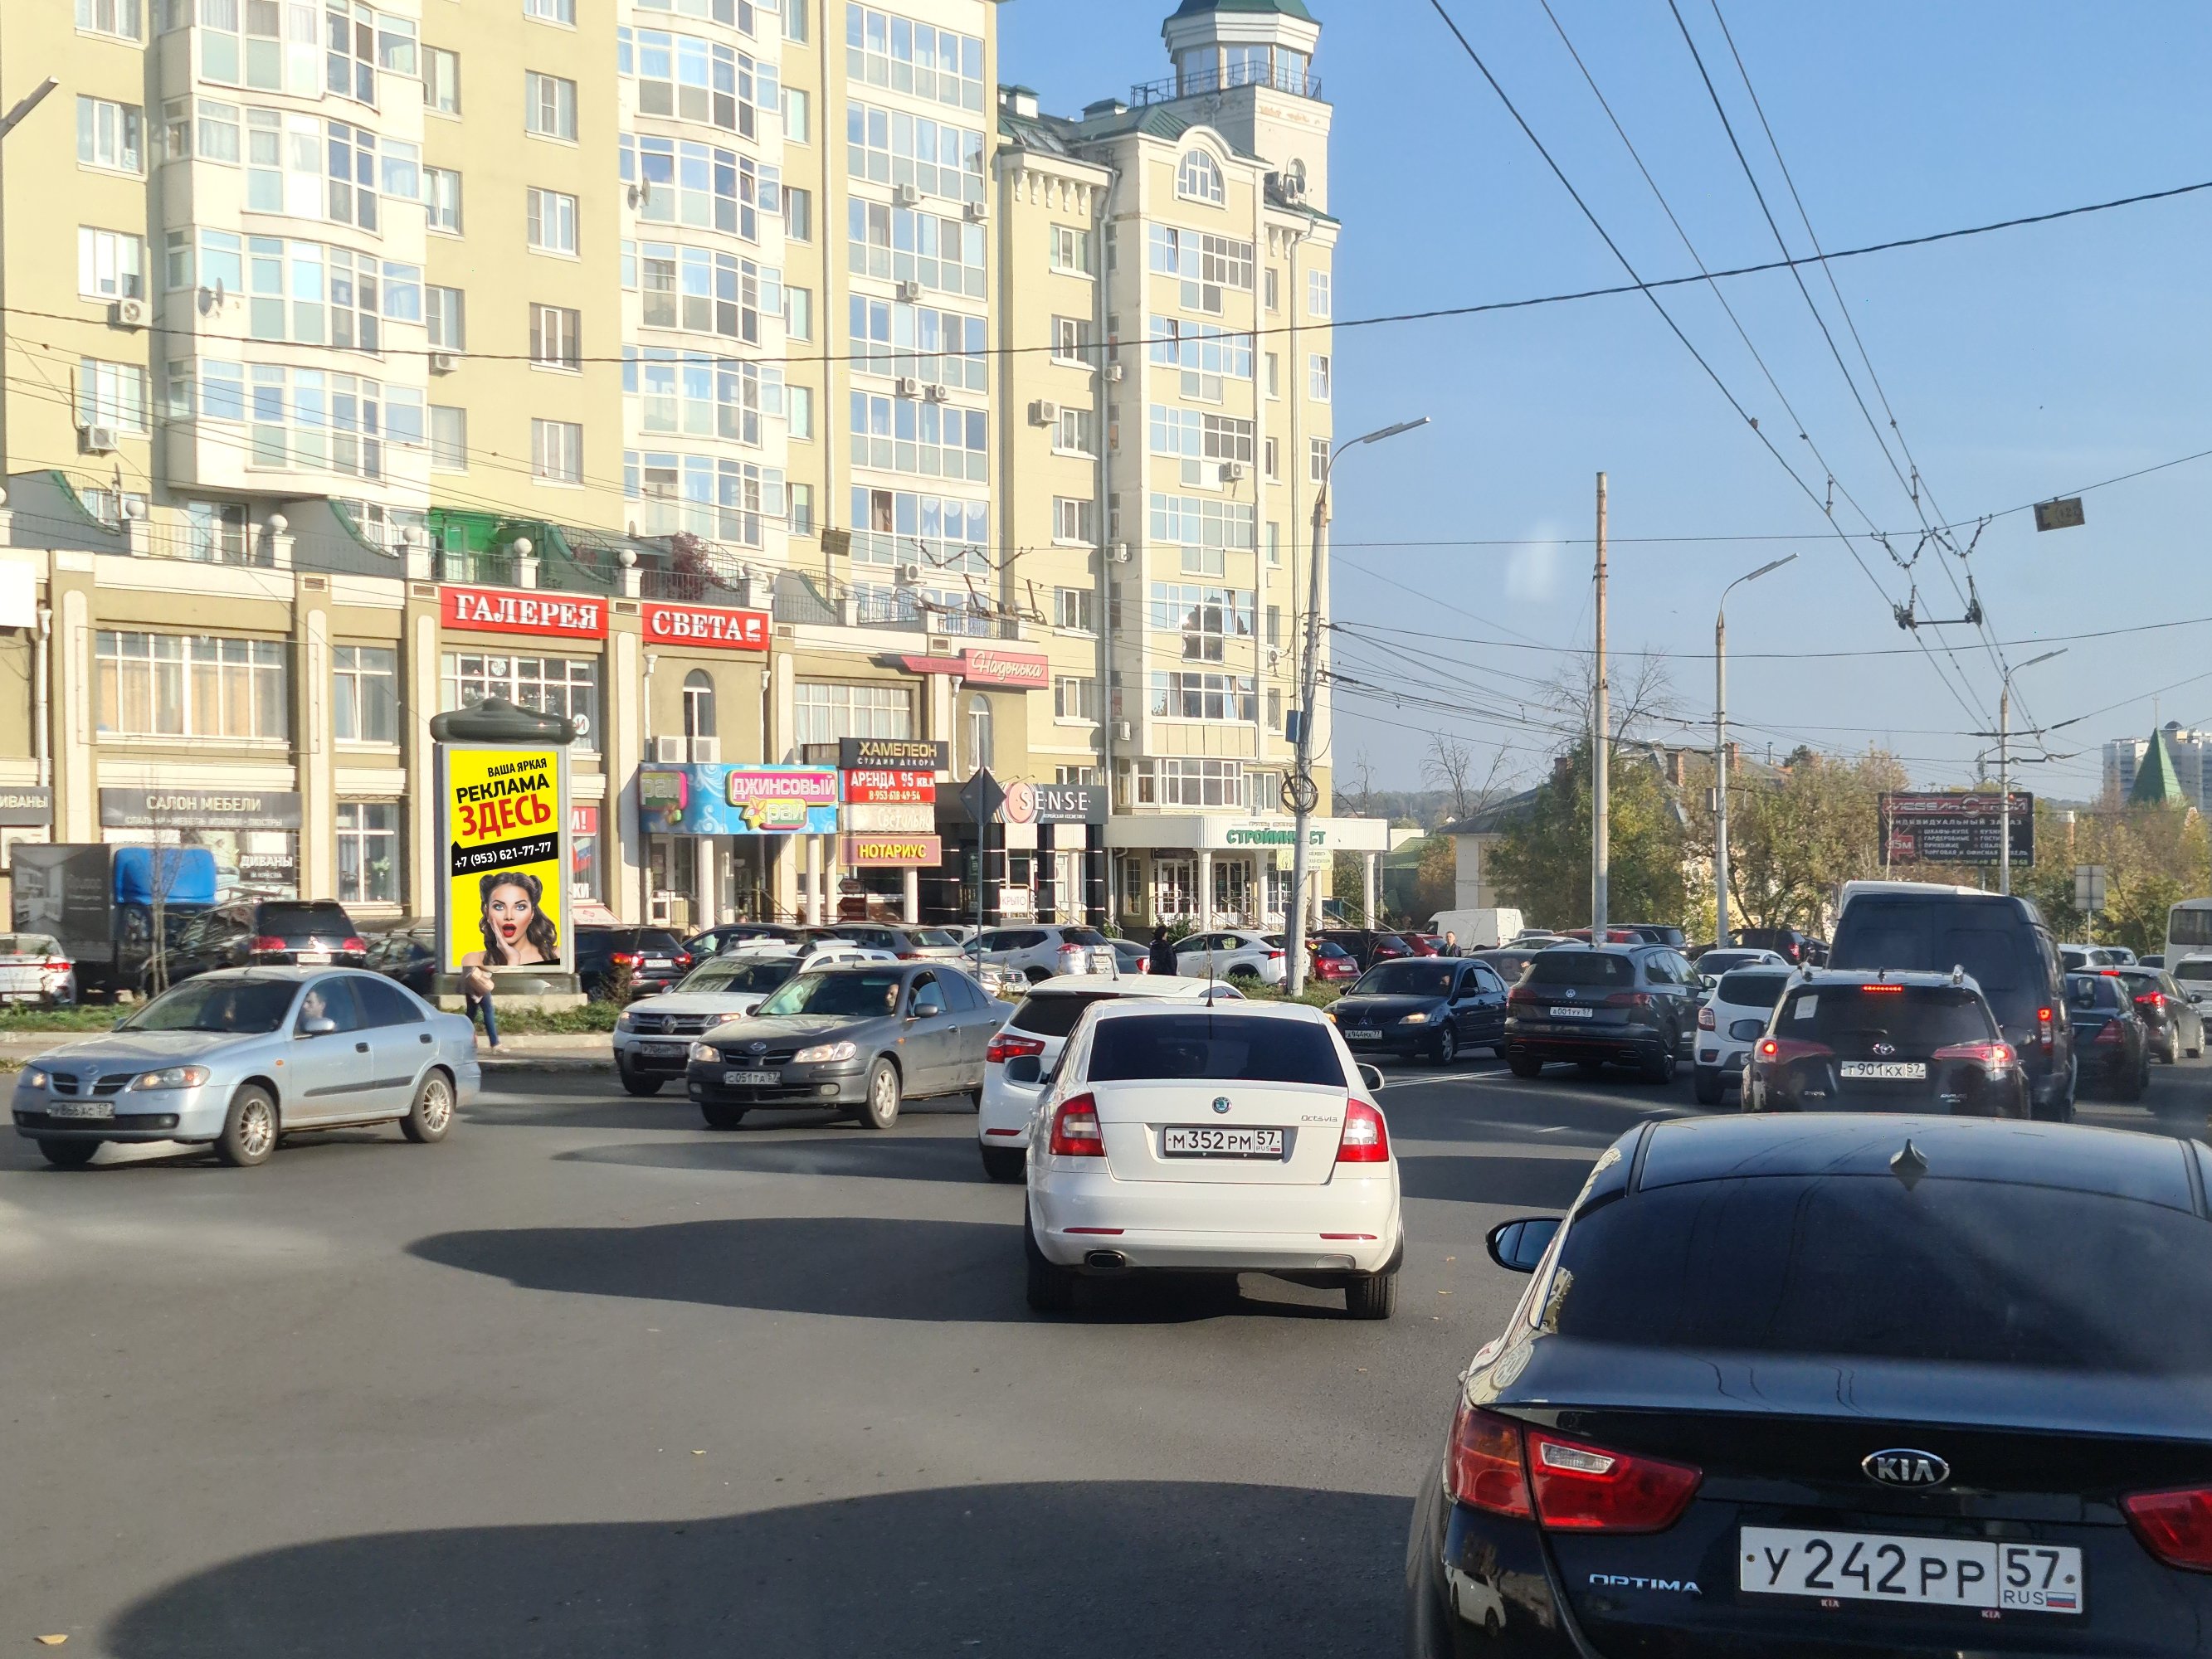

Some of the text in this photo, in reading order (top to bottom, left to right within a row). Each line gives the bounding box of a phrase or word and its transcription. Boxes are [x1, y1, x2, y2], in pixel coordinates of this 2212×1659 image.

[456, 594, 743, 640] ГАЛЕРЕЯ СВЕТА
[859, 742, 938, 757] ХАМЕЛЕОН
[487, 758, 548, 777] ВАША ЯРКАЯ
[857, 757, 935, 766] СТУДИЯ ДЕКОРА
[456, 773, 550, 804] РЕКЛАМА
[733, 776, 836, 799] ДЖИНСОВЫЙ
[850, 771, 896, 789] АРЕНДА
[900, 772, 914, 787] 95
[146, 795, 261, 811] САЛОН МЕБЕЛИ
[869, 791, 921, 800] 8-953-618-49-54
[459, 793, 551, 839] ЗДЕСЬ
[767, 800, 804, 824] рай
[1226, 828, 1326, 844] СТРОЙИНСТ
[455, 841, 552, 868] +7 (953) 621-77-77
[859, 844, 927, 859] НОТАРИУС
[240, 855, 293, 868] ДИВАНЫ
[1001, 897, 1026, 906] КРЫТО
[1847, 1063, 1920, 1077] Т901КХ 57
[1173, 1131, 1275, 1150] М352РМ 57
[1877, 1457, 1935, 1481] KIA
[2006, 1548, 2059, 1589] 57
[1589, 1574, 1703, 1594] OPTIMA
[1821, 1599, 1840, 1608] KIA
[2004, 1590, 2044, 1605] RUS
[1981, 1610, 2001, 1618] KIA
